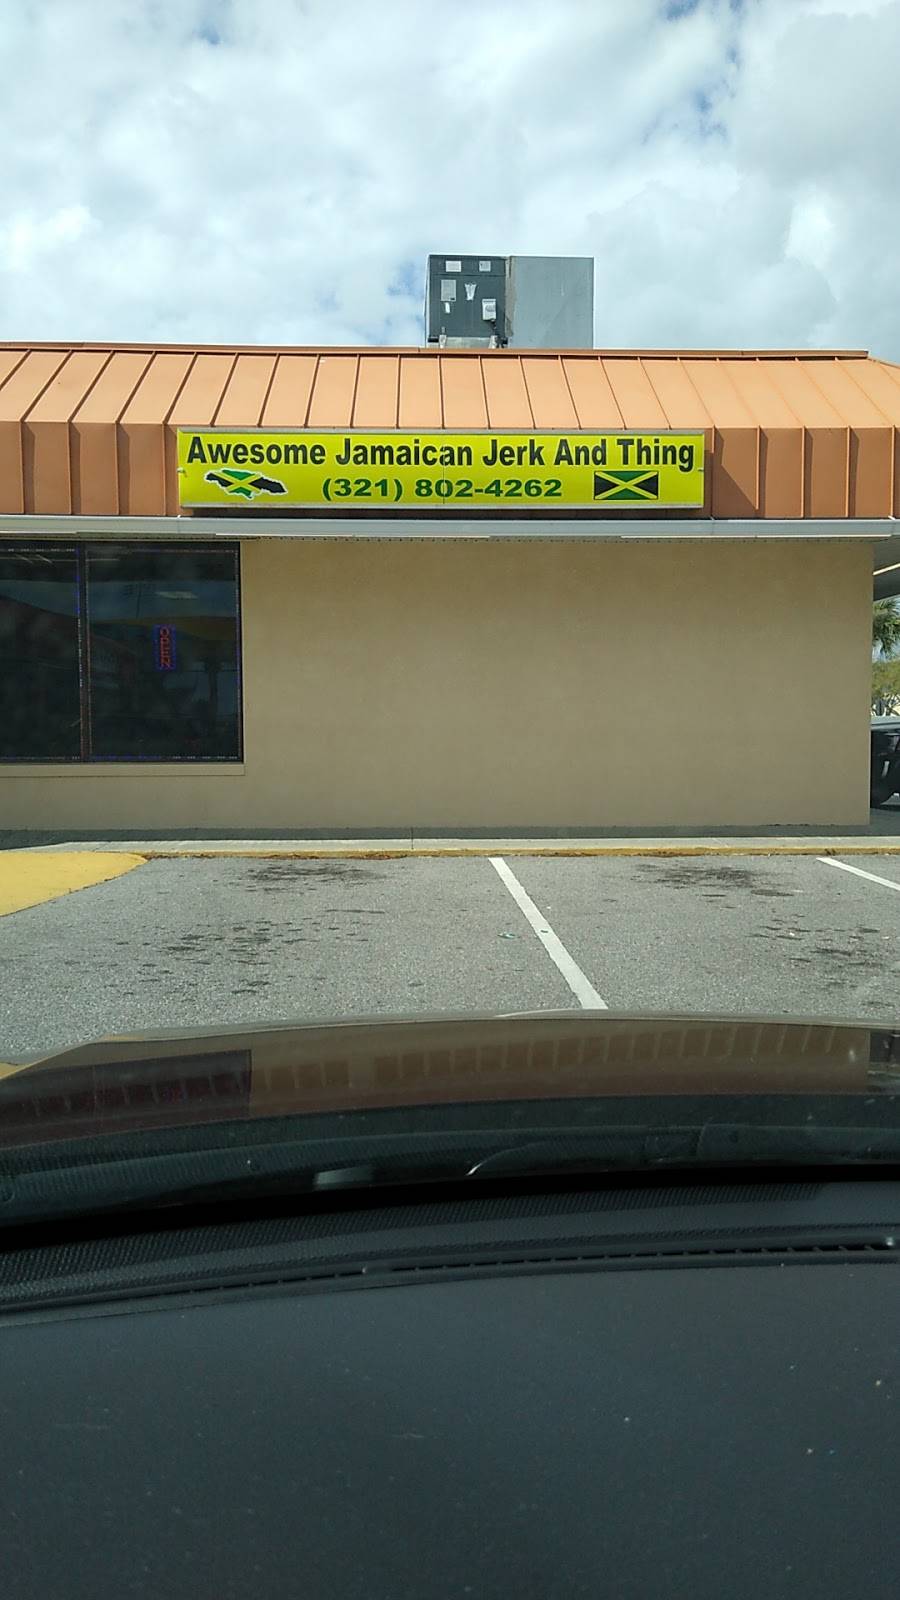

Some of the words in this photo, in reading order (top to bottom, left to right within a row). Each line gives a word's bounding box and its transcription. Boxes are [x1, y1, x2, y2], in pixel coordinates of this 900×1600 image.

[187, 436, 326, 465] Awesome
[335, 438, 473, 466] Jamaican
[482, 439, 545, 466] Jerk
[554, 439, 607, 466] And
[617, 438, 694, 472] Thing
[322, 478, 402, 501] (321)
[414, 479, 562, 498] 802-4262
[159, 627, 170, 669] OPEN
